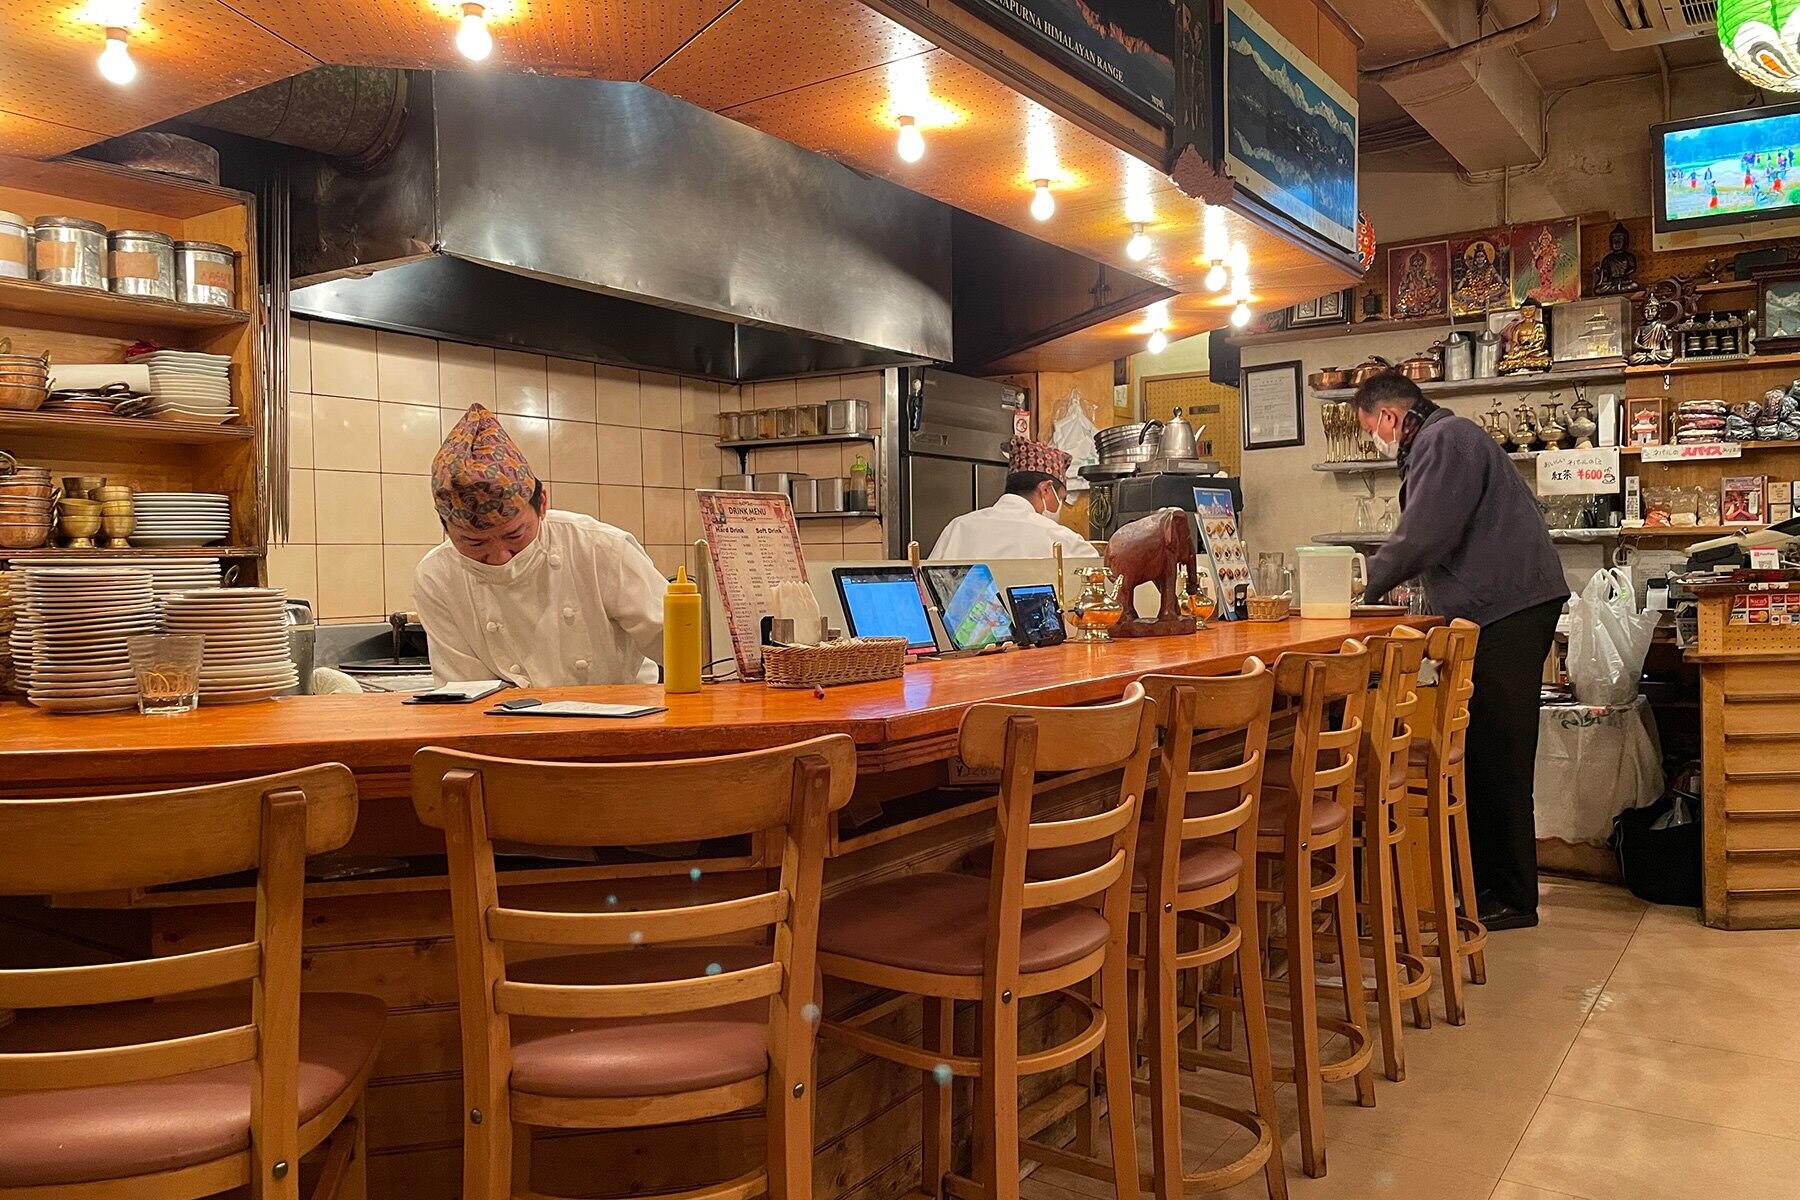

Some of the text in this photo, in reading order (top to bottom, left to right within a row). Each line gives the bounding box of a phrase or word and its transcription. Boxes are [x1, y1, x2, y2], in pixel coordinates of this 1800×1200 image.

[997, 0, 1124, 83] APURNA HIMALAYAN RANGE
[1681, 446, 1723, 457] スパイス
[1551, 468, 1602, 481] 紅茶 ¥600
[728, 507, 767, 516] DRINK MENU
